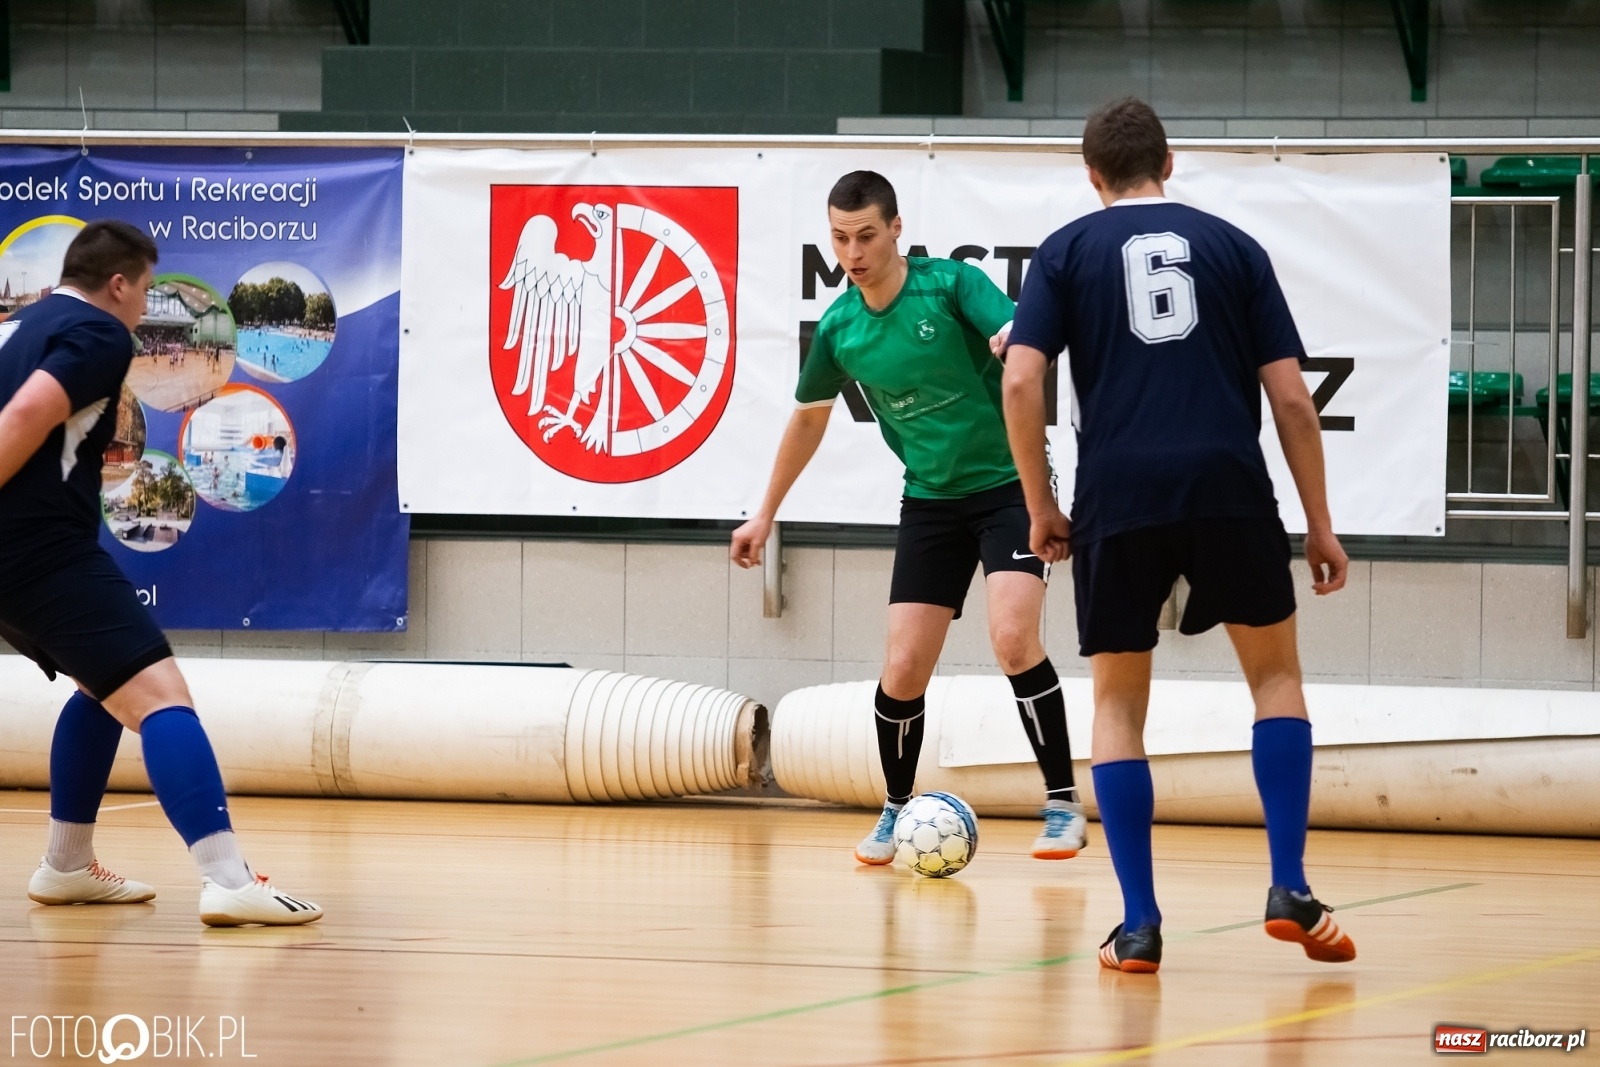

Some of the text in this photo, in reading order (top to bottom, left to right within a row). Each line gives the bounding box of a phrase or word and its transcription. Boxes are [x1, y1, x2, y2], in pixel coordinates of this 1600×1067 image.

[78, 175, 164, 206] Sportu
[174, 176, 181, 201] i
[191, 176, 317, 207] Rekreacji
[148, 215, 317, 241] w Raciborzu
[1121, 231, 1199, 345] 6
